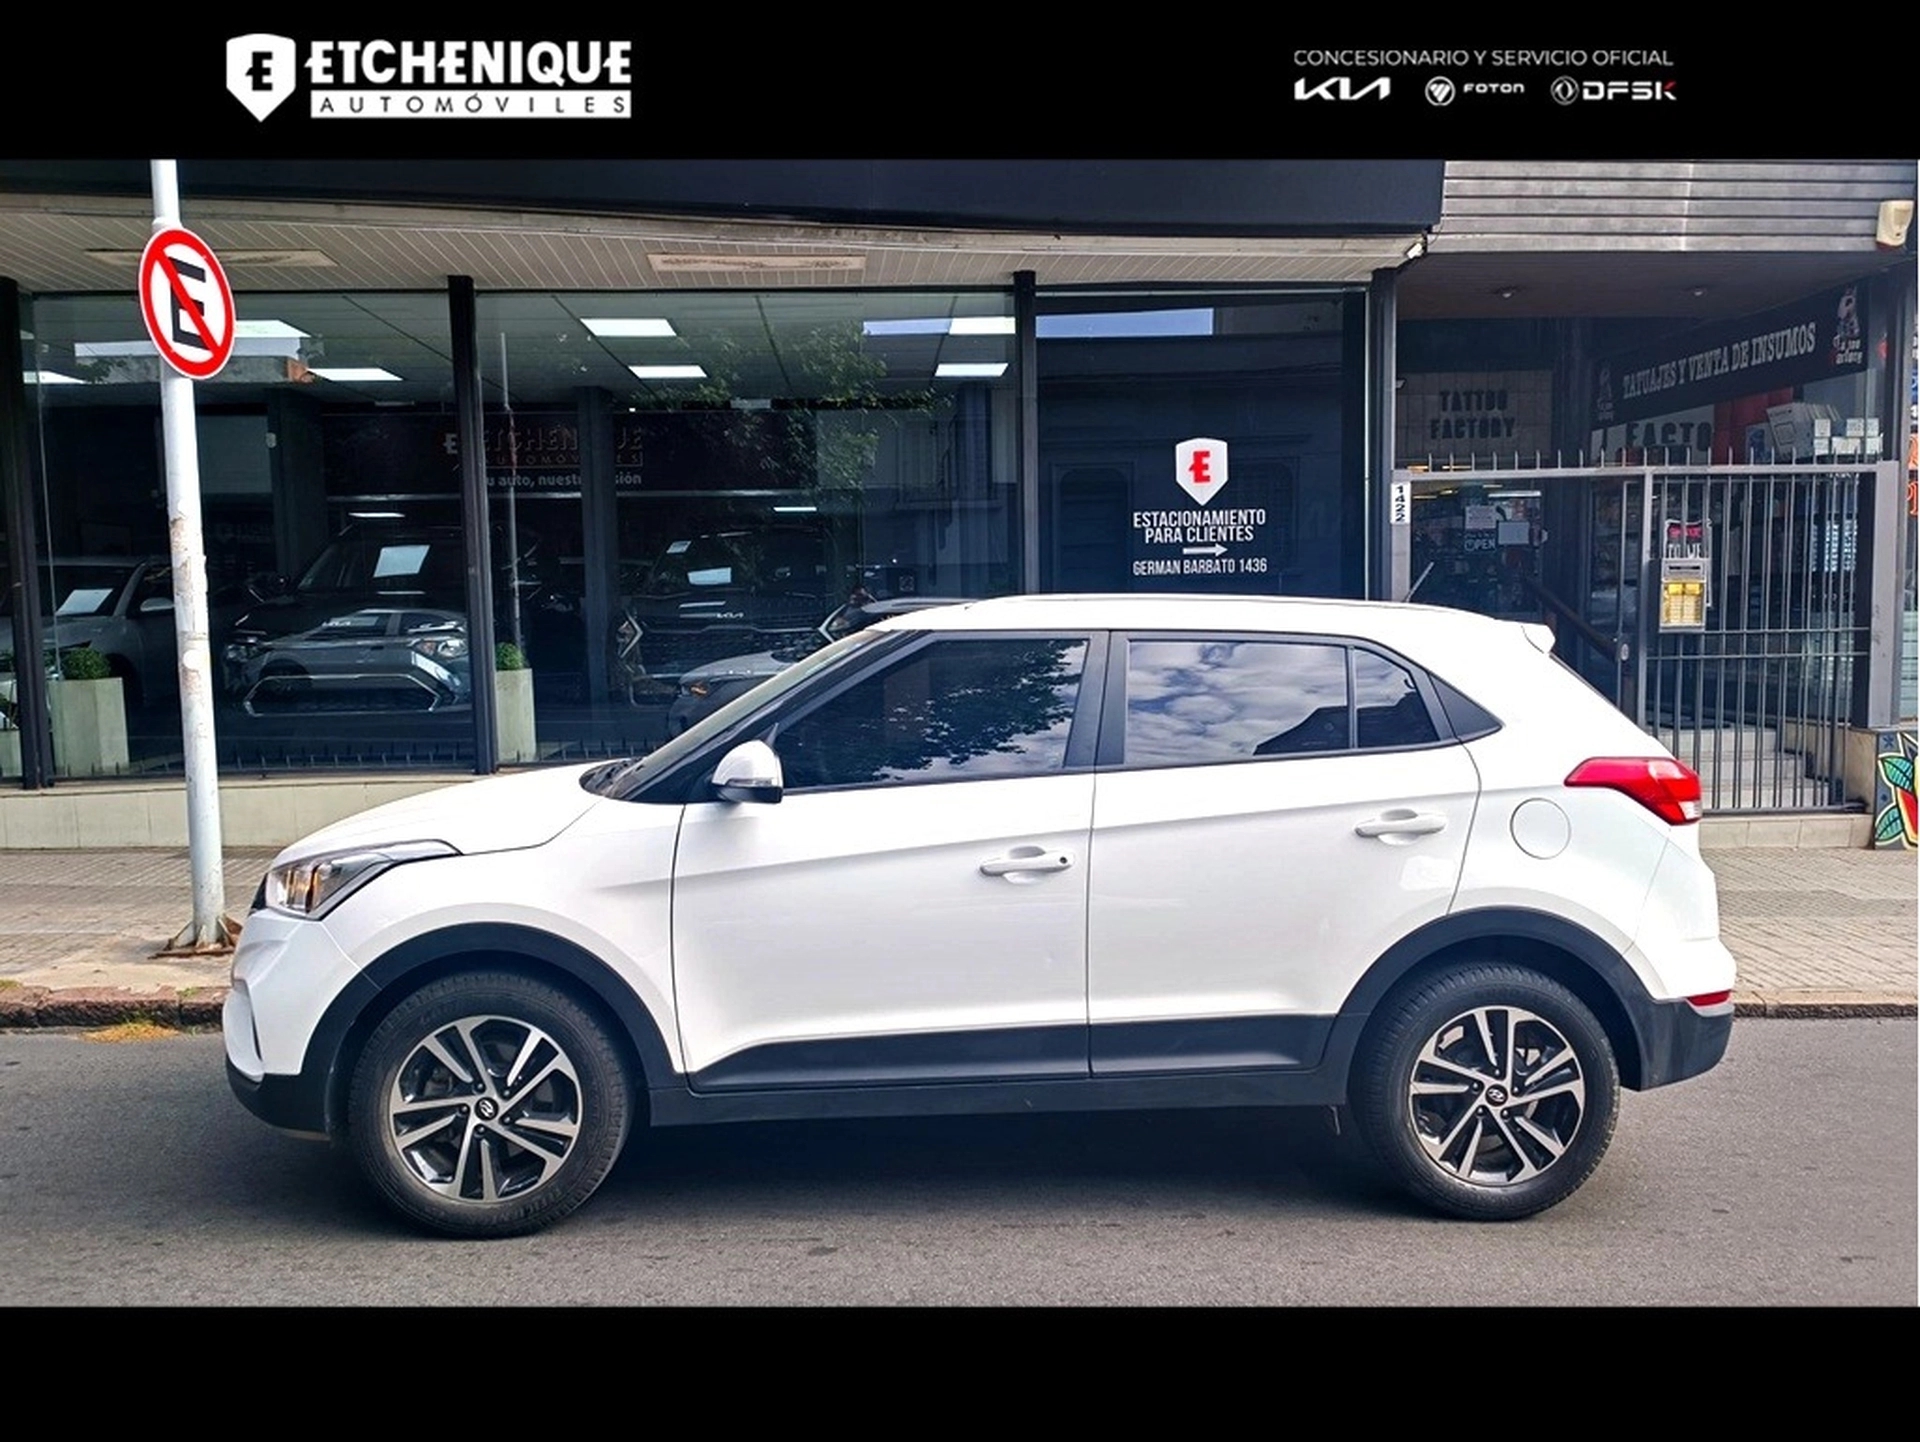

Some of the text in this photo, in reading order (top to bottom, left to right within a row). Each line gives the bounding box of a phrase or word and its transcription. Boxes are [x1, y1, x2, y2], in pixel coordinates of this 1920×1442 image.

[168, 257, 207, 351] E
[1622, 359, 1678, 399] TATUAJES
[1688, 346, 1730, 382] VENTA
[1730, 340, 1749, 372] DE
[1750, 321, 1817, 367] INSUMOS
[1431, 417, 1515, 440] FACTORY
[1189, 450, 1211, 483] E
[1394, 485, 1406, 523] 1422
[1133, 509, 1266, 529] ESTACIONAMIENTO
[1145, 525, 1254, 544] PARA CLIENTES
[1132, 558, 1268, 576] GERMAN BARBATO 1436
